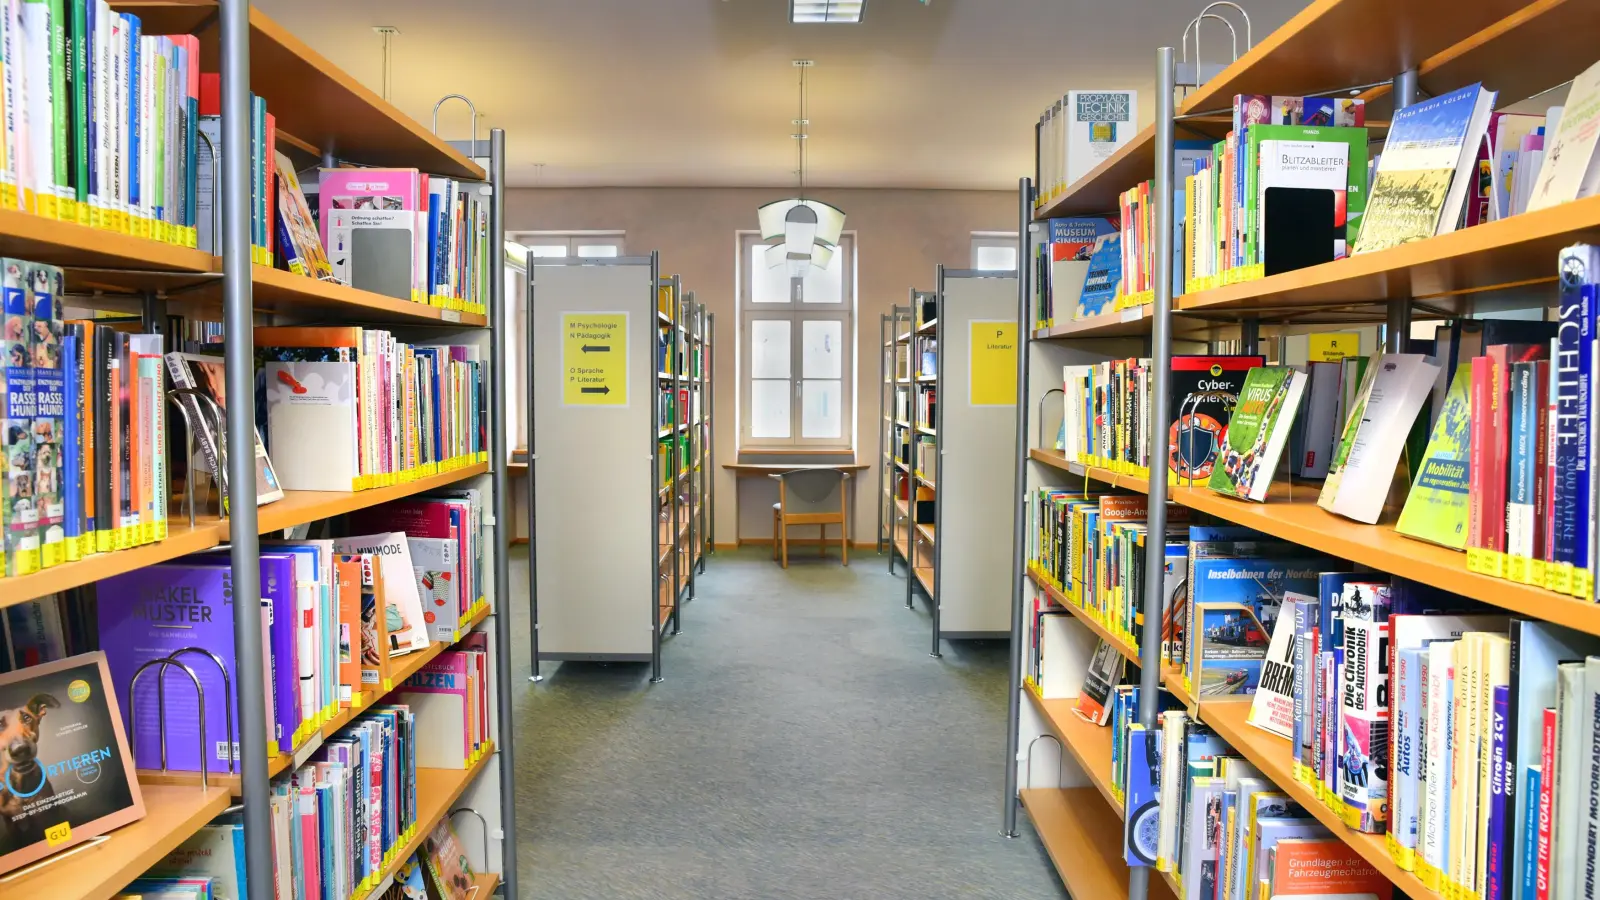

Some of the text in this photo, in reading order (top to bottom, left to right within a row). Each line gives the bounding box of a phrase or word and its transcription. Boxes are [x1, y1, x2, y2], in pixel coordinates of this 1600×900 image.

[1080, 94, 1126, 102] PROPYLÄEN
[1080, 102, 1126, 113] TECHNIK
[1418, 103, 1440, 116] MARIA
[1443, 92, 1472, 106] KOLDAU
[1056, 228, 1096, 238] MUSEUM
[576, 332, 611, 340] Pädagogik
[577, 322, 618, 330] Psychologie
[1198, 380, 1235, 391] Cyber-
[1558, 303, 1580, 446] SCHIFFE
[1248, 388, 1272, 402] VIRUS
[1518, 370, 1529, 502] Keyboards, MIDI, Homerecording
[1426, 462, 1465, 479] Mobilität
[1564, 456, 1576, 541] 5000 JAHRE
[357, 543, 402, 556] MINIMODE
[364, 558, 372, 583] TOPP
[1208, 570, 1318, 580] Inselbahnen der Nordse
[133, 604, 212, 622] MUSTER
[1294, 608, 1305, 722] Kein Stress beim TÜV
[1344, 626, 1356, 708] Die Chronik
[1354, 628, 1366, 711] des Automobils
[404, 673, 455, 689] FILZEN
[1482, 672, 1490, 722] CABRIOS
[1396, 710, 1404, 772] Deutsche
[1402, 734, 1410, 776] Autos
[1589, 692, 1600, 821] MOTORRADTECHNIK
[1427, 702, 1440, 848] Michael Klier Der Kater
[1493, 746, 1504, 795] Citroën
[12, 792, 88, 822] STEP-BY-STEP-PROGRAMM
[23, 789, 75, 810] DAS EINZIGARTIGE
[1538, 790, 1550, 890] OFF THE ROAD.
[1230, 827, 1240, 894] Polizeifahrzeuge
[1288, 858, 1360, 871] Grundlagen der
